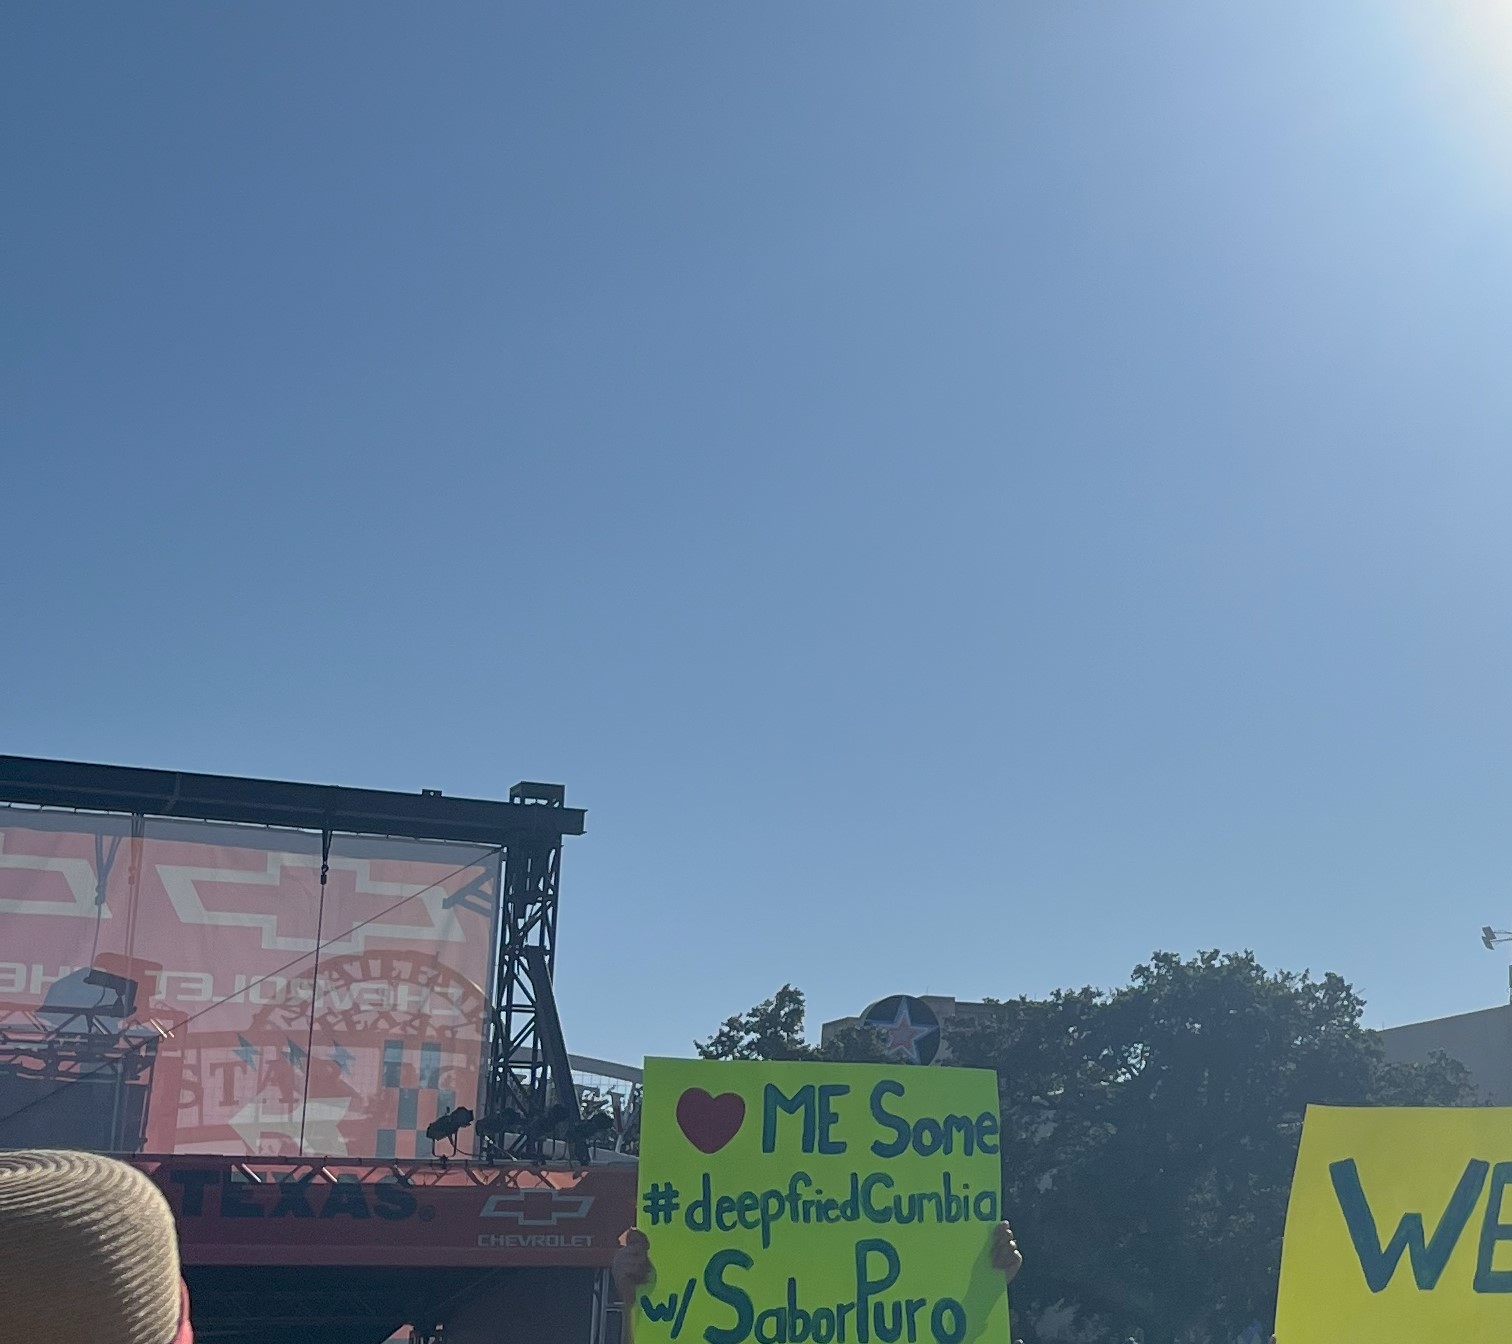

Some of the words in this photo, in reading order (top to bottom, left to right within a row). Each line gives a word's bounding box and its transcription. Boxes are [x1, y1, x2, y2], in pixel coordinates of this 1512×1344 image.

[762, 1083, 850, 1154] ME
[869, 1080, 999, 1157] Some
[477, 1234, 595, 1247] CHEVROLET
[643, 1171, 997, 1248] #deepfriedCumbia
[640, 1278, 697, 1339] w/
